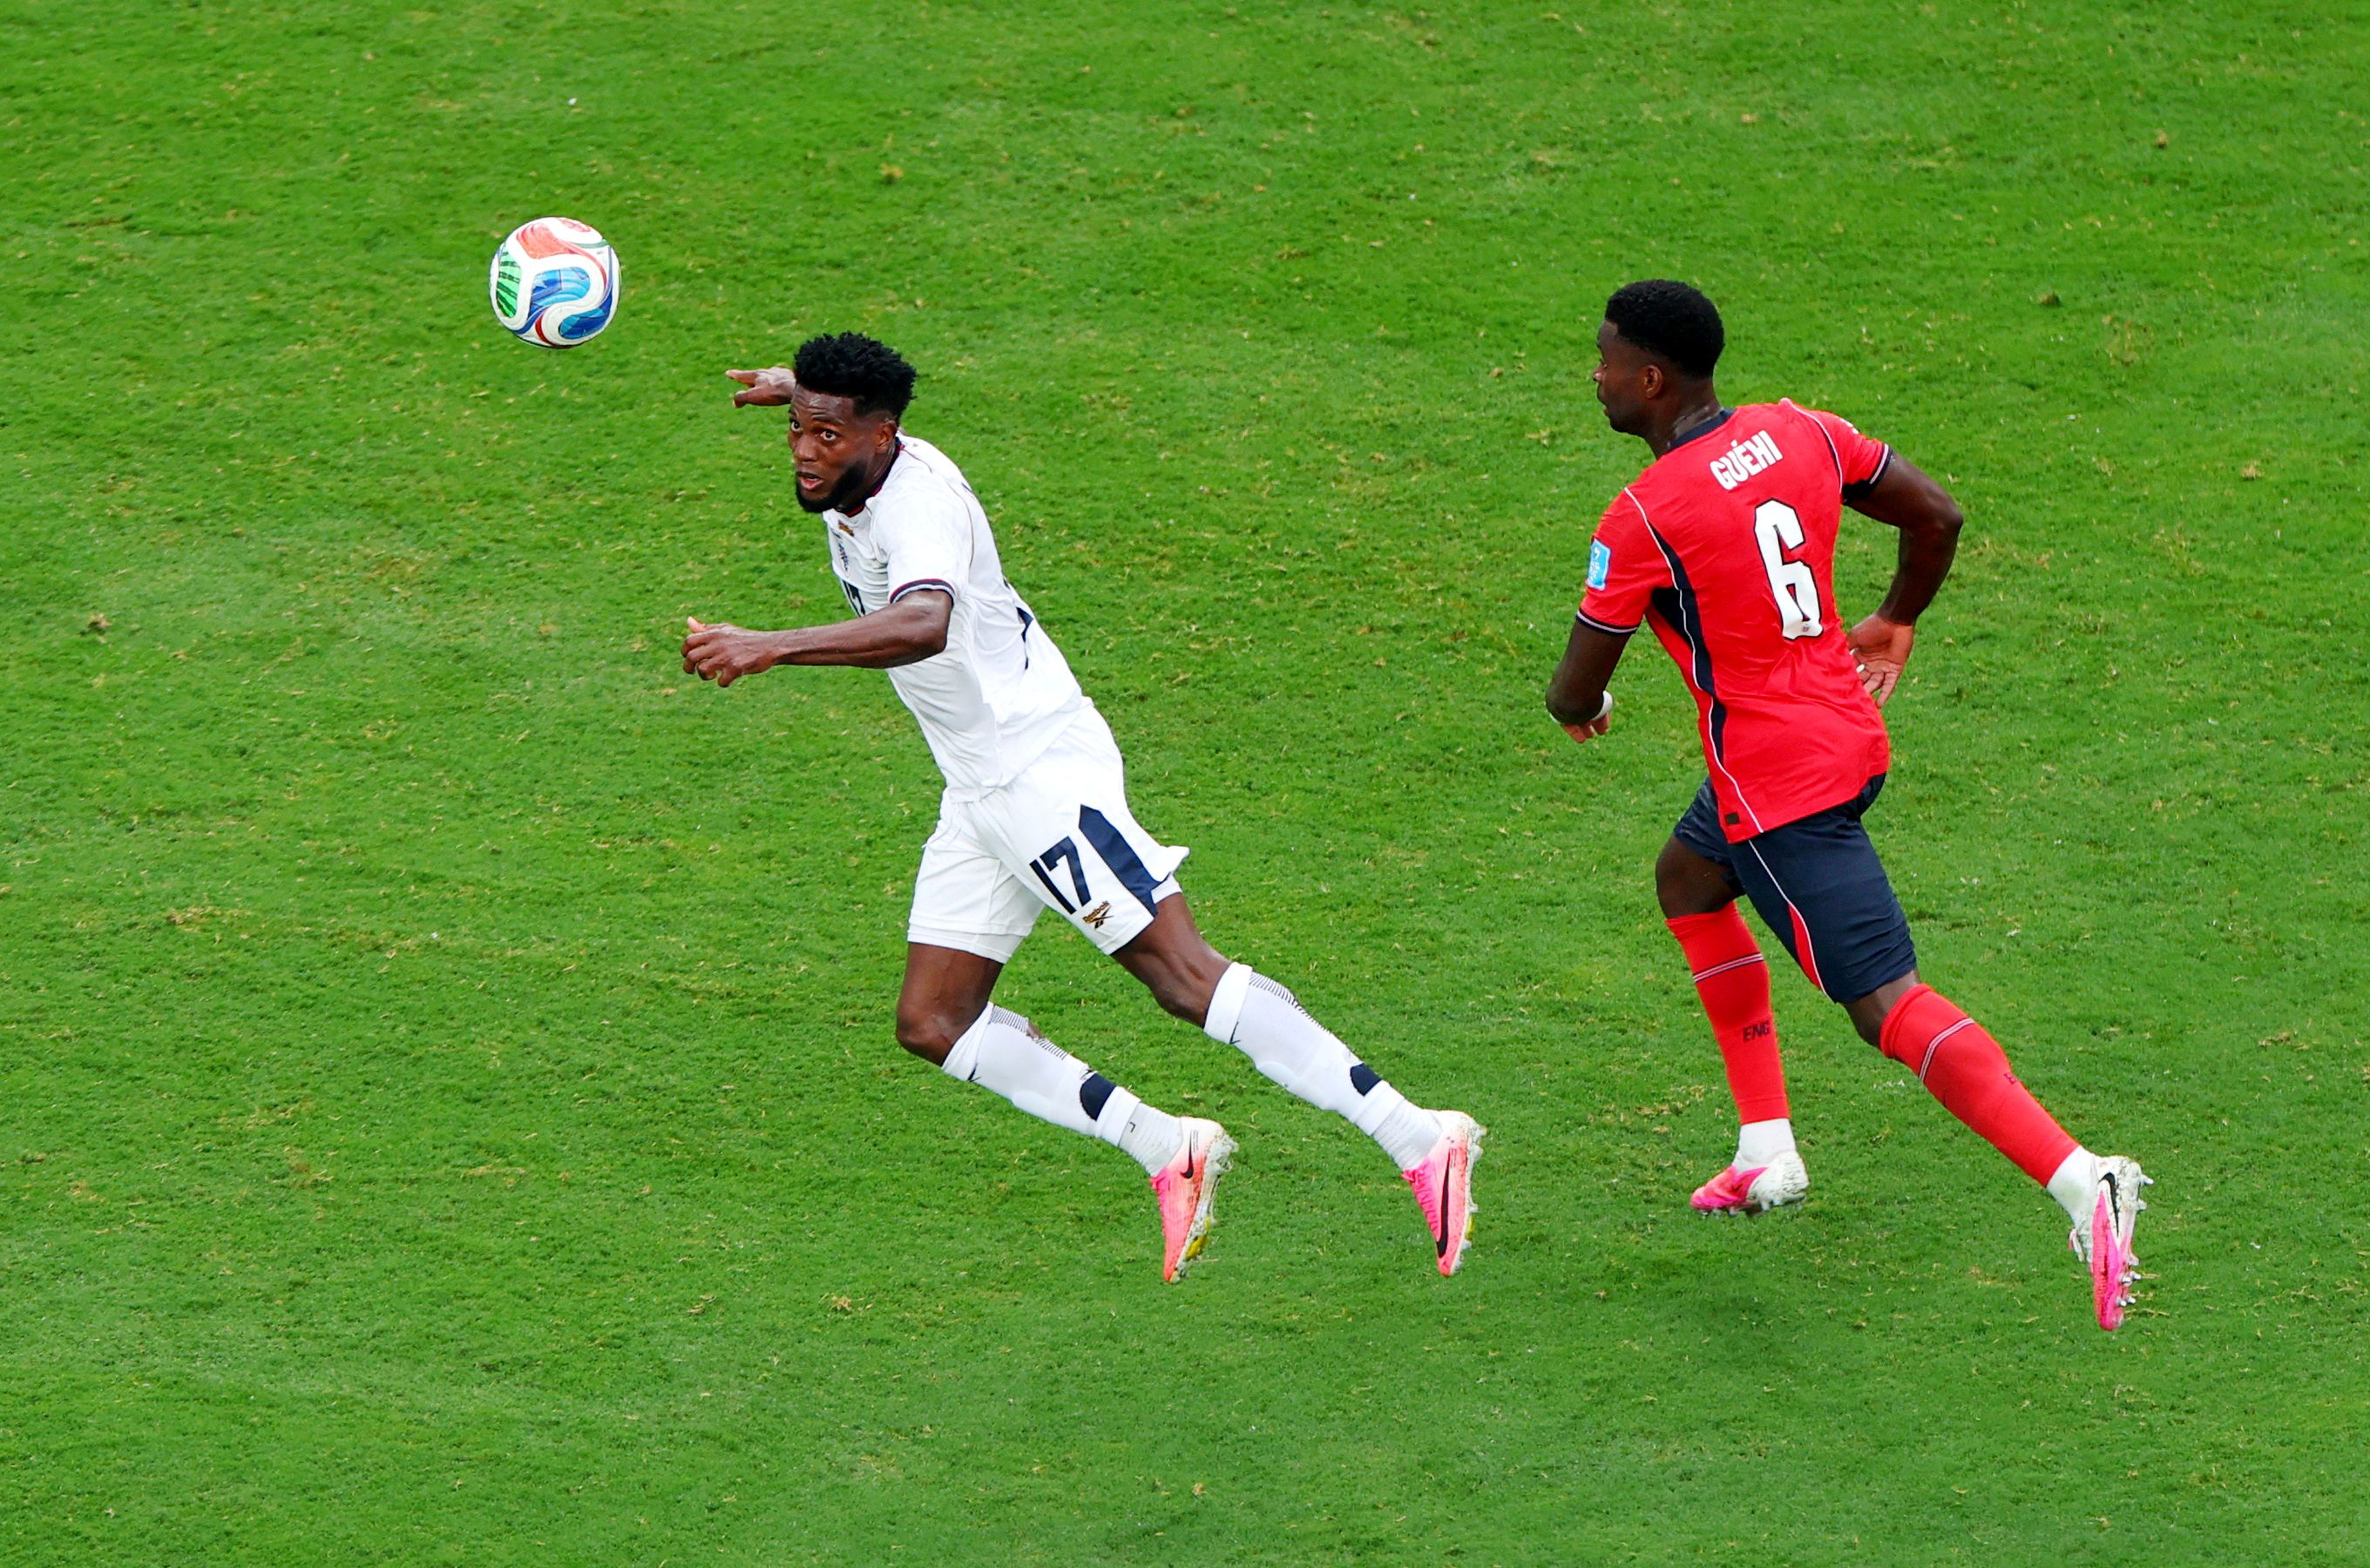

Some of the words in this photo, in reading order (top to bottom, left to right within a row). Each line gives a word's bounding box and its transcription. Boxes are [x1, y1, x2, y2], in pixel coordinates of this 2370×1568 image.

[1710, 429, 1784, 490] GUÉHI
[1753, 497, 1824, 641] 6
[1029, 835, 1092, 916] 17
[1743, 1020, 1771, 1044] ENG
